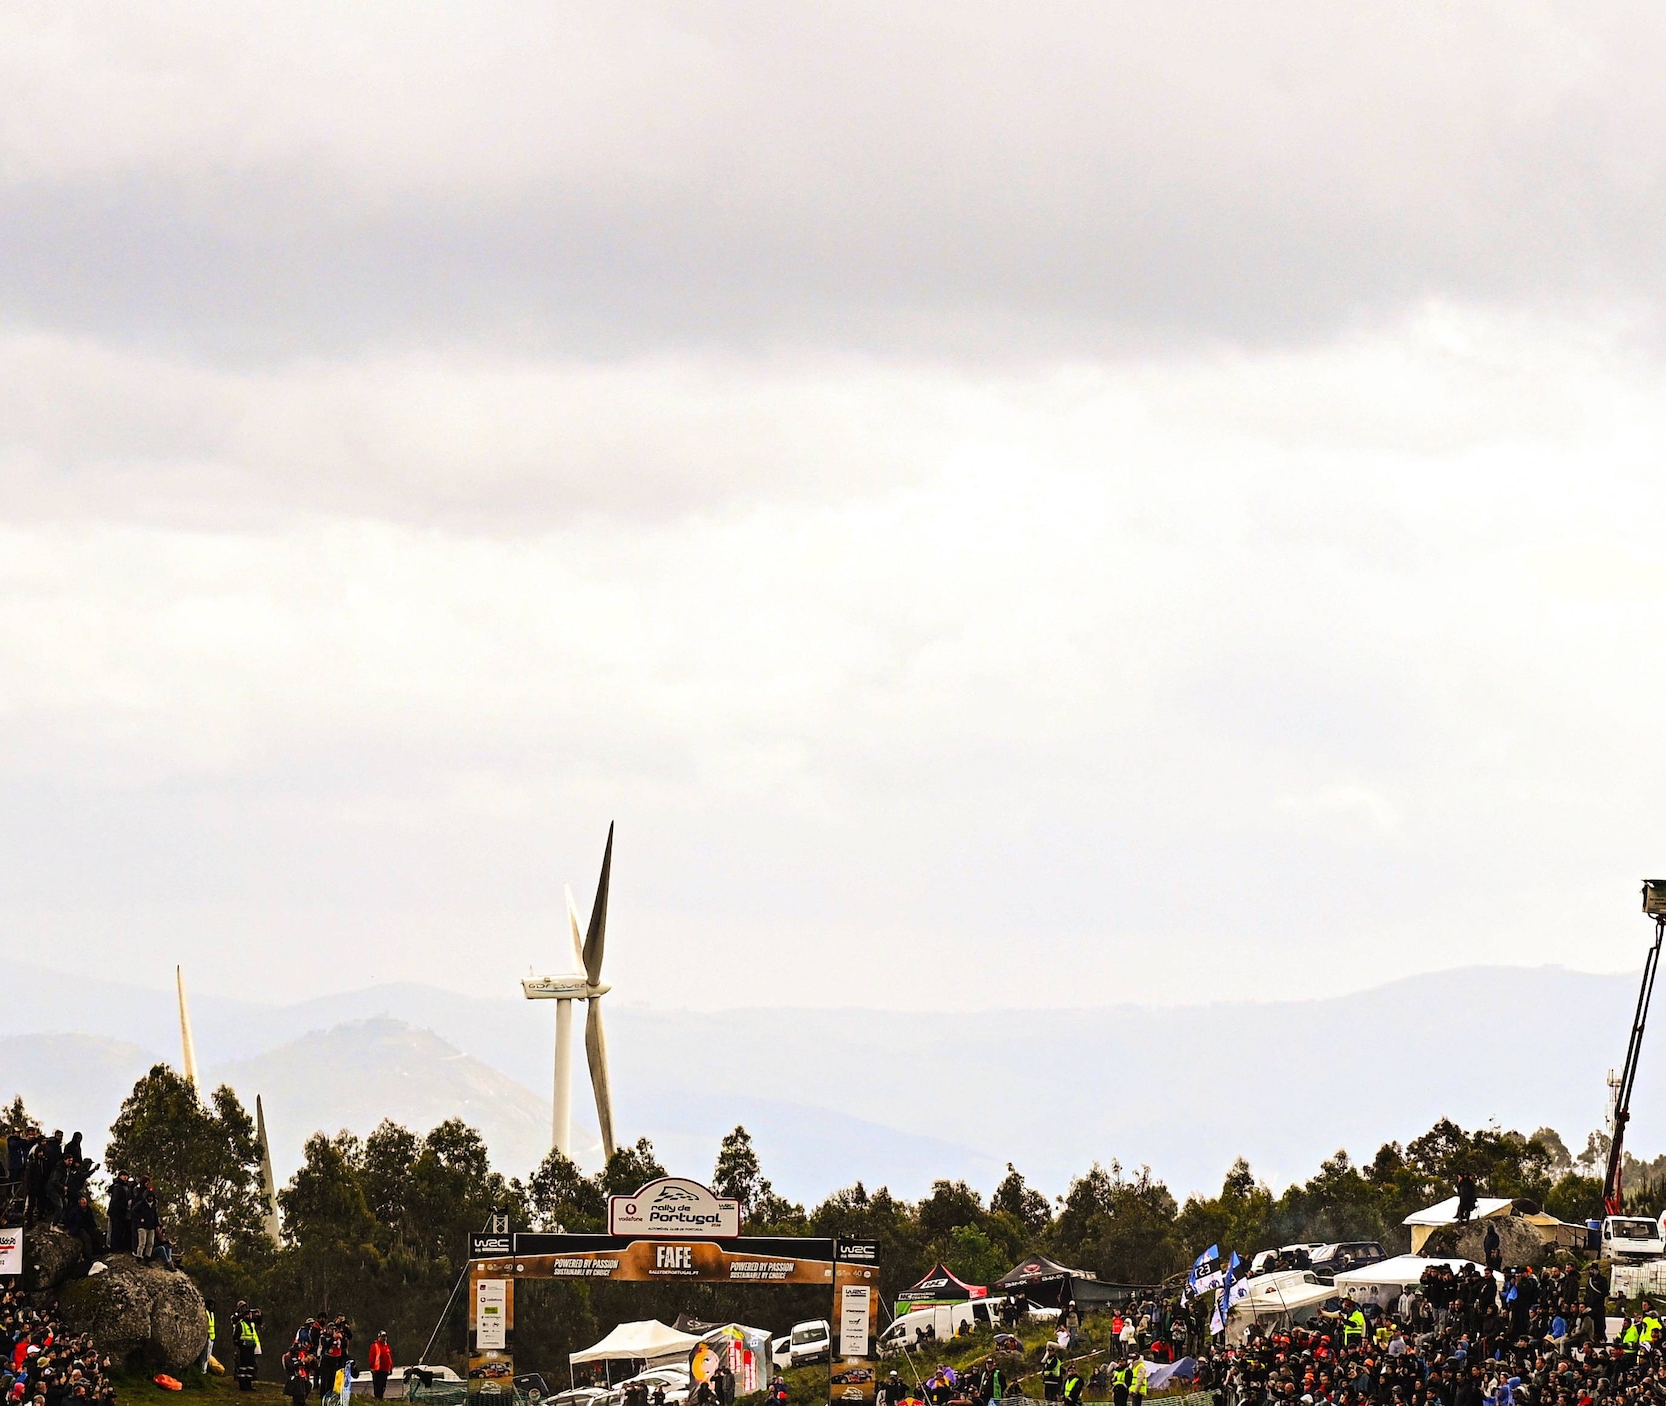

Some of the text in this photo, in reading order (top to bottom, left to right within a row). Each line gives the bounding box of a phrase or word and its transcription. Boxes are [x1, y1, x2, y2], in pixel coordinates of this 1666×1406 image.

[651, 1205, 676, 1213] rally
[649, 1212, 722, 1225] Portugal
[474, 1239, 510, 1248] WRC
[840, 1245, 875, 1255] WRC
[656, 1246, 692, 1268] FAFE
[553, 1259, 619, 1269] POWERED BY PASSION
[729, 1262, 795, 1272] POWERED BY PASSION
[593, 1269, 611, 1277] CHOICE
[729, 1271, 761, 1279] SUSTAINABLE
